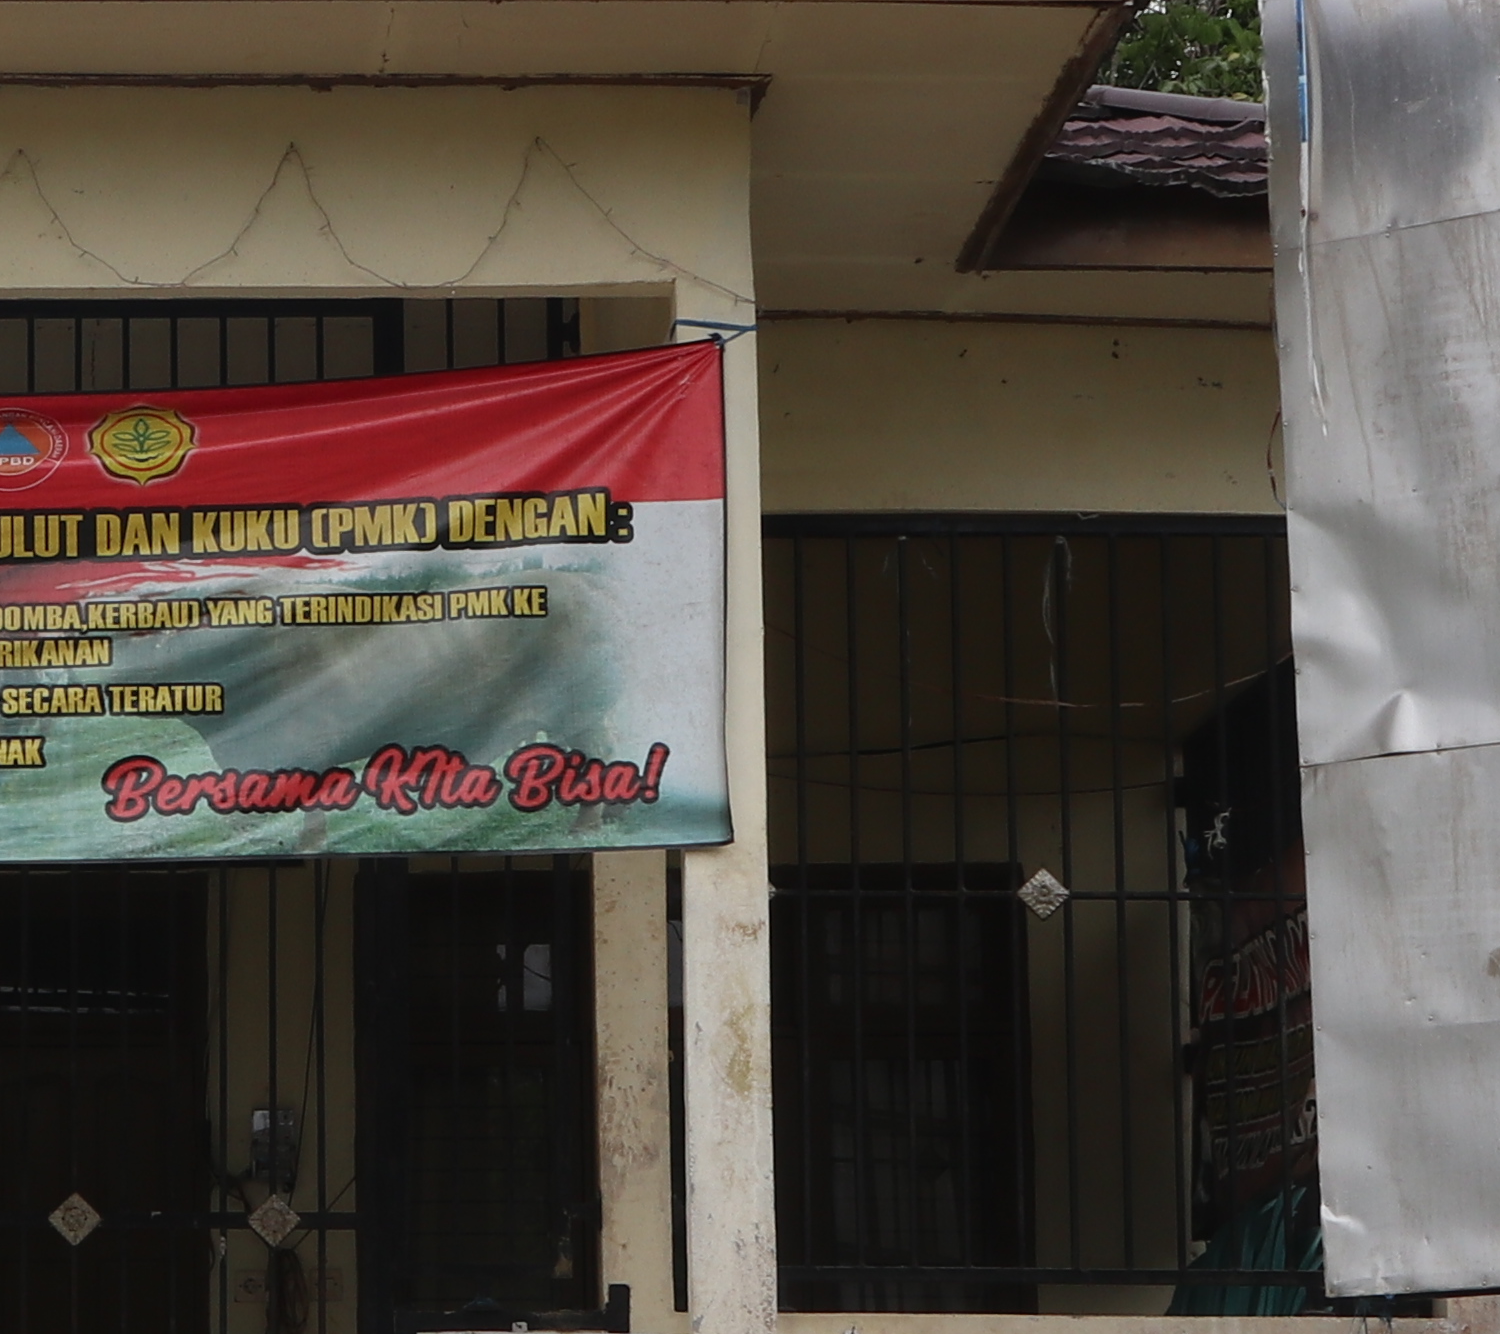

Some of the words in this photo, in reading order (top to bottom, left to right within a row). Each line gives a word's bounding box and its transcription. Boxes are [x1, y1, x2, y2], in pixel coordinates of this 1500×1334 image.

[96, 512, 180, 557] DAN
[192, 508, 300, 553] KUKU
[311, 502, 433, 548] (PMK)
[206, 599, 273, 625] YANG
[280, 593, 442, 624] TERINDIKASI
[450, 589, 508, 617] PMK
[513, 587, 547, 616] KE
[2, 687, 102, 714] SECARA
[109, 685, 222, 712] TERATUR
[107, 760, 355, 819] Bersama
[507, 744, 669, 806] Bisa!
